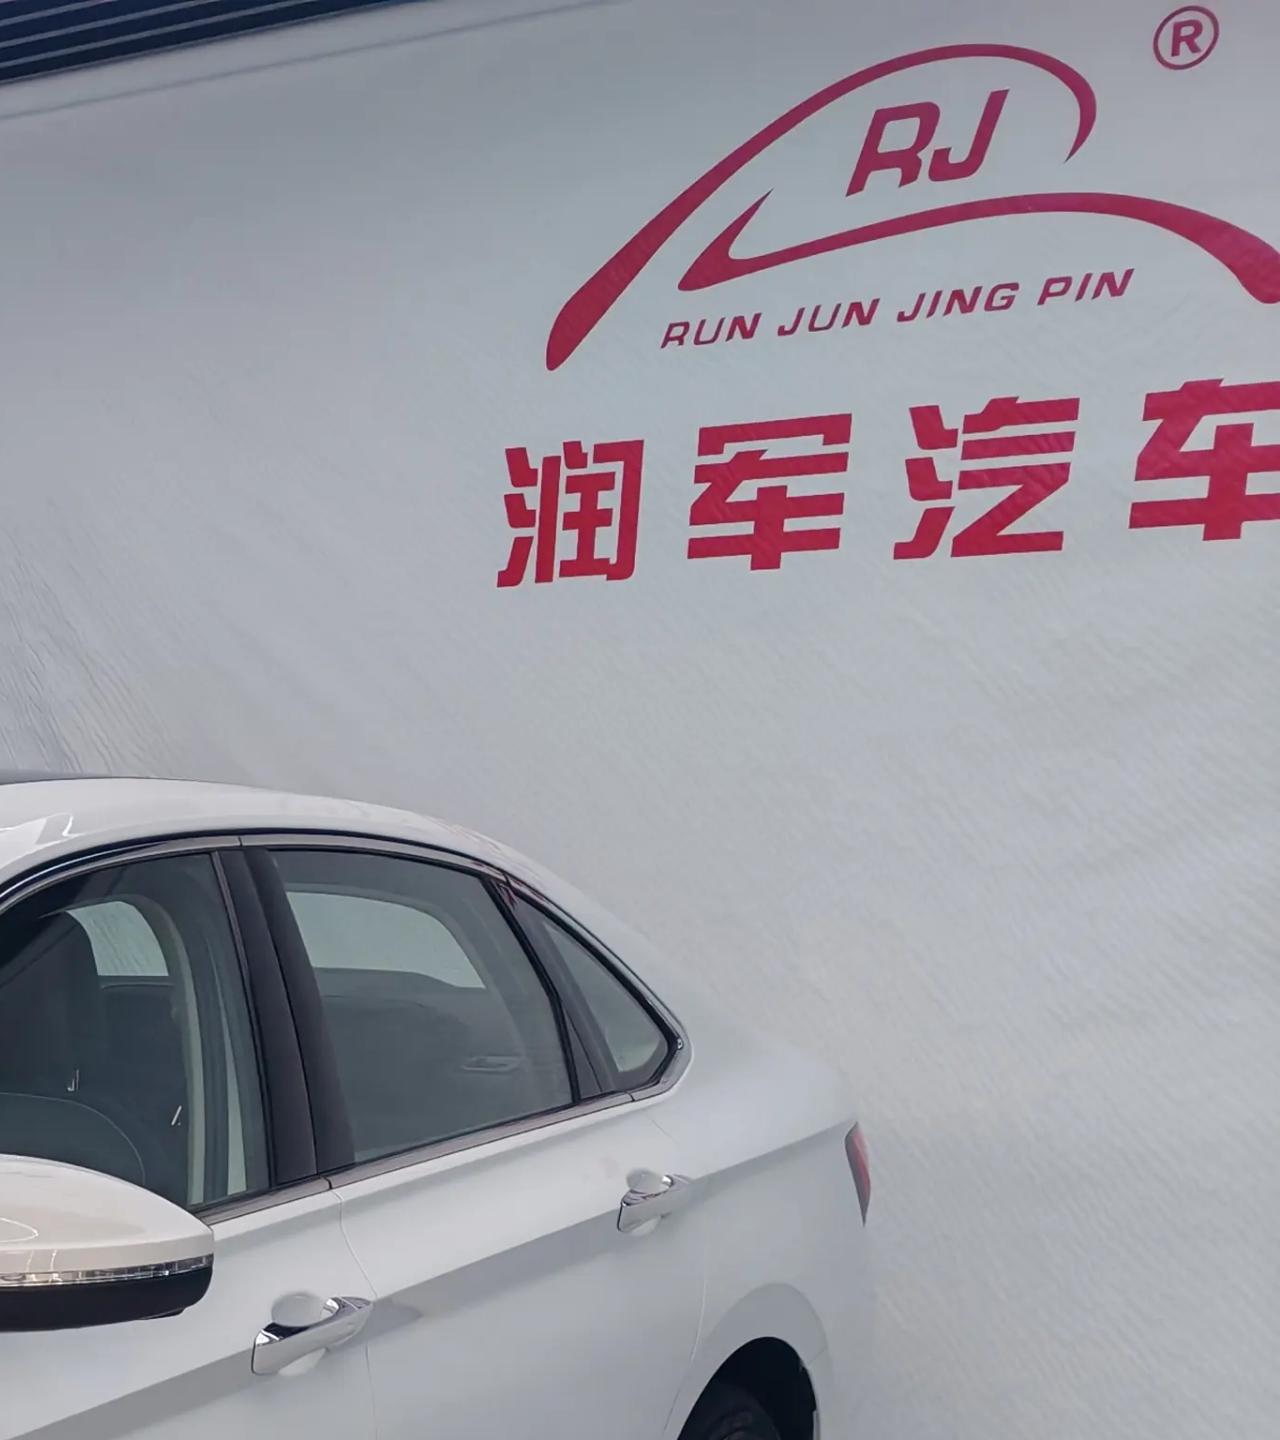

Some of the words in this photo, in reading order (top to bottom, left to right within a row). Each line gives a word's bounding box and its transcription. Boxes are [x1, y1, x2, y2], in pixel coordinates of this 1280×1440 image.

[846, 89, 1009, 197] RJ
[661, 313, 760, 348] RUN
[778, 299, 878, 337] JUN
[897, 282, 1020, 322] JING
[1038, 268, 1134, 306] PIN
[496, 378, 1280, 588] 润军汽车
